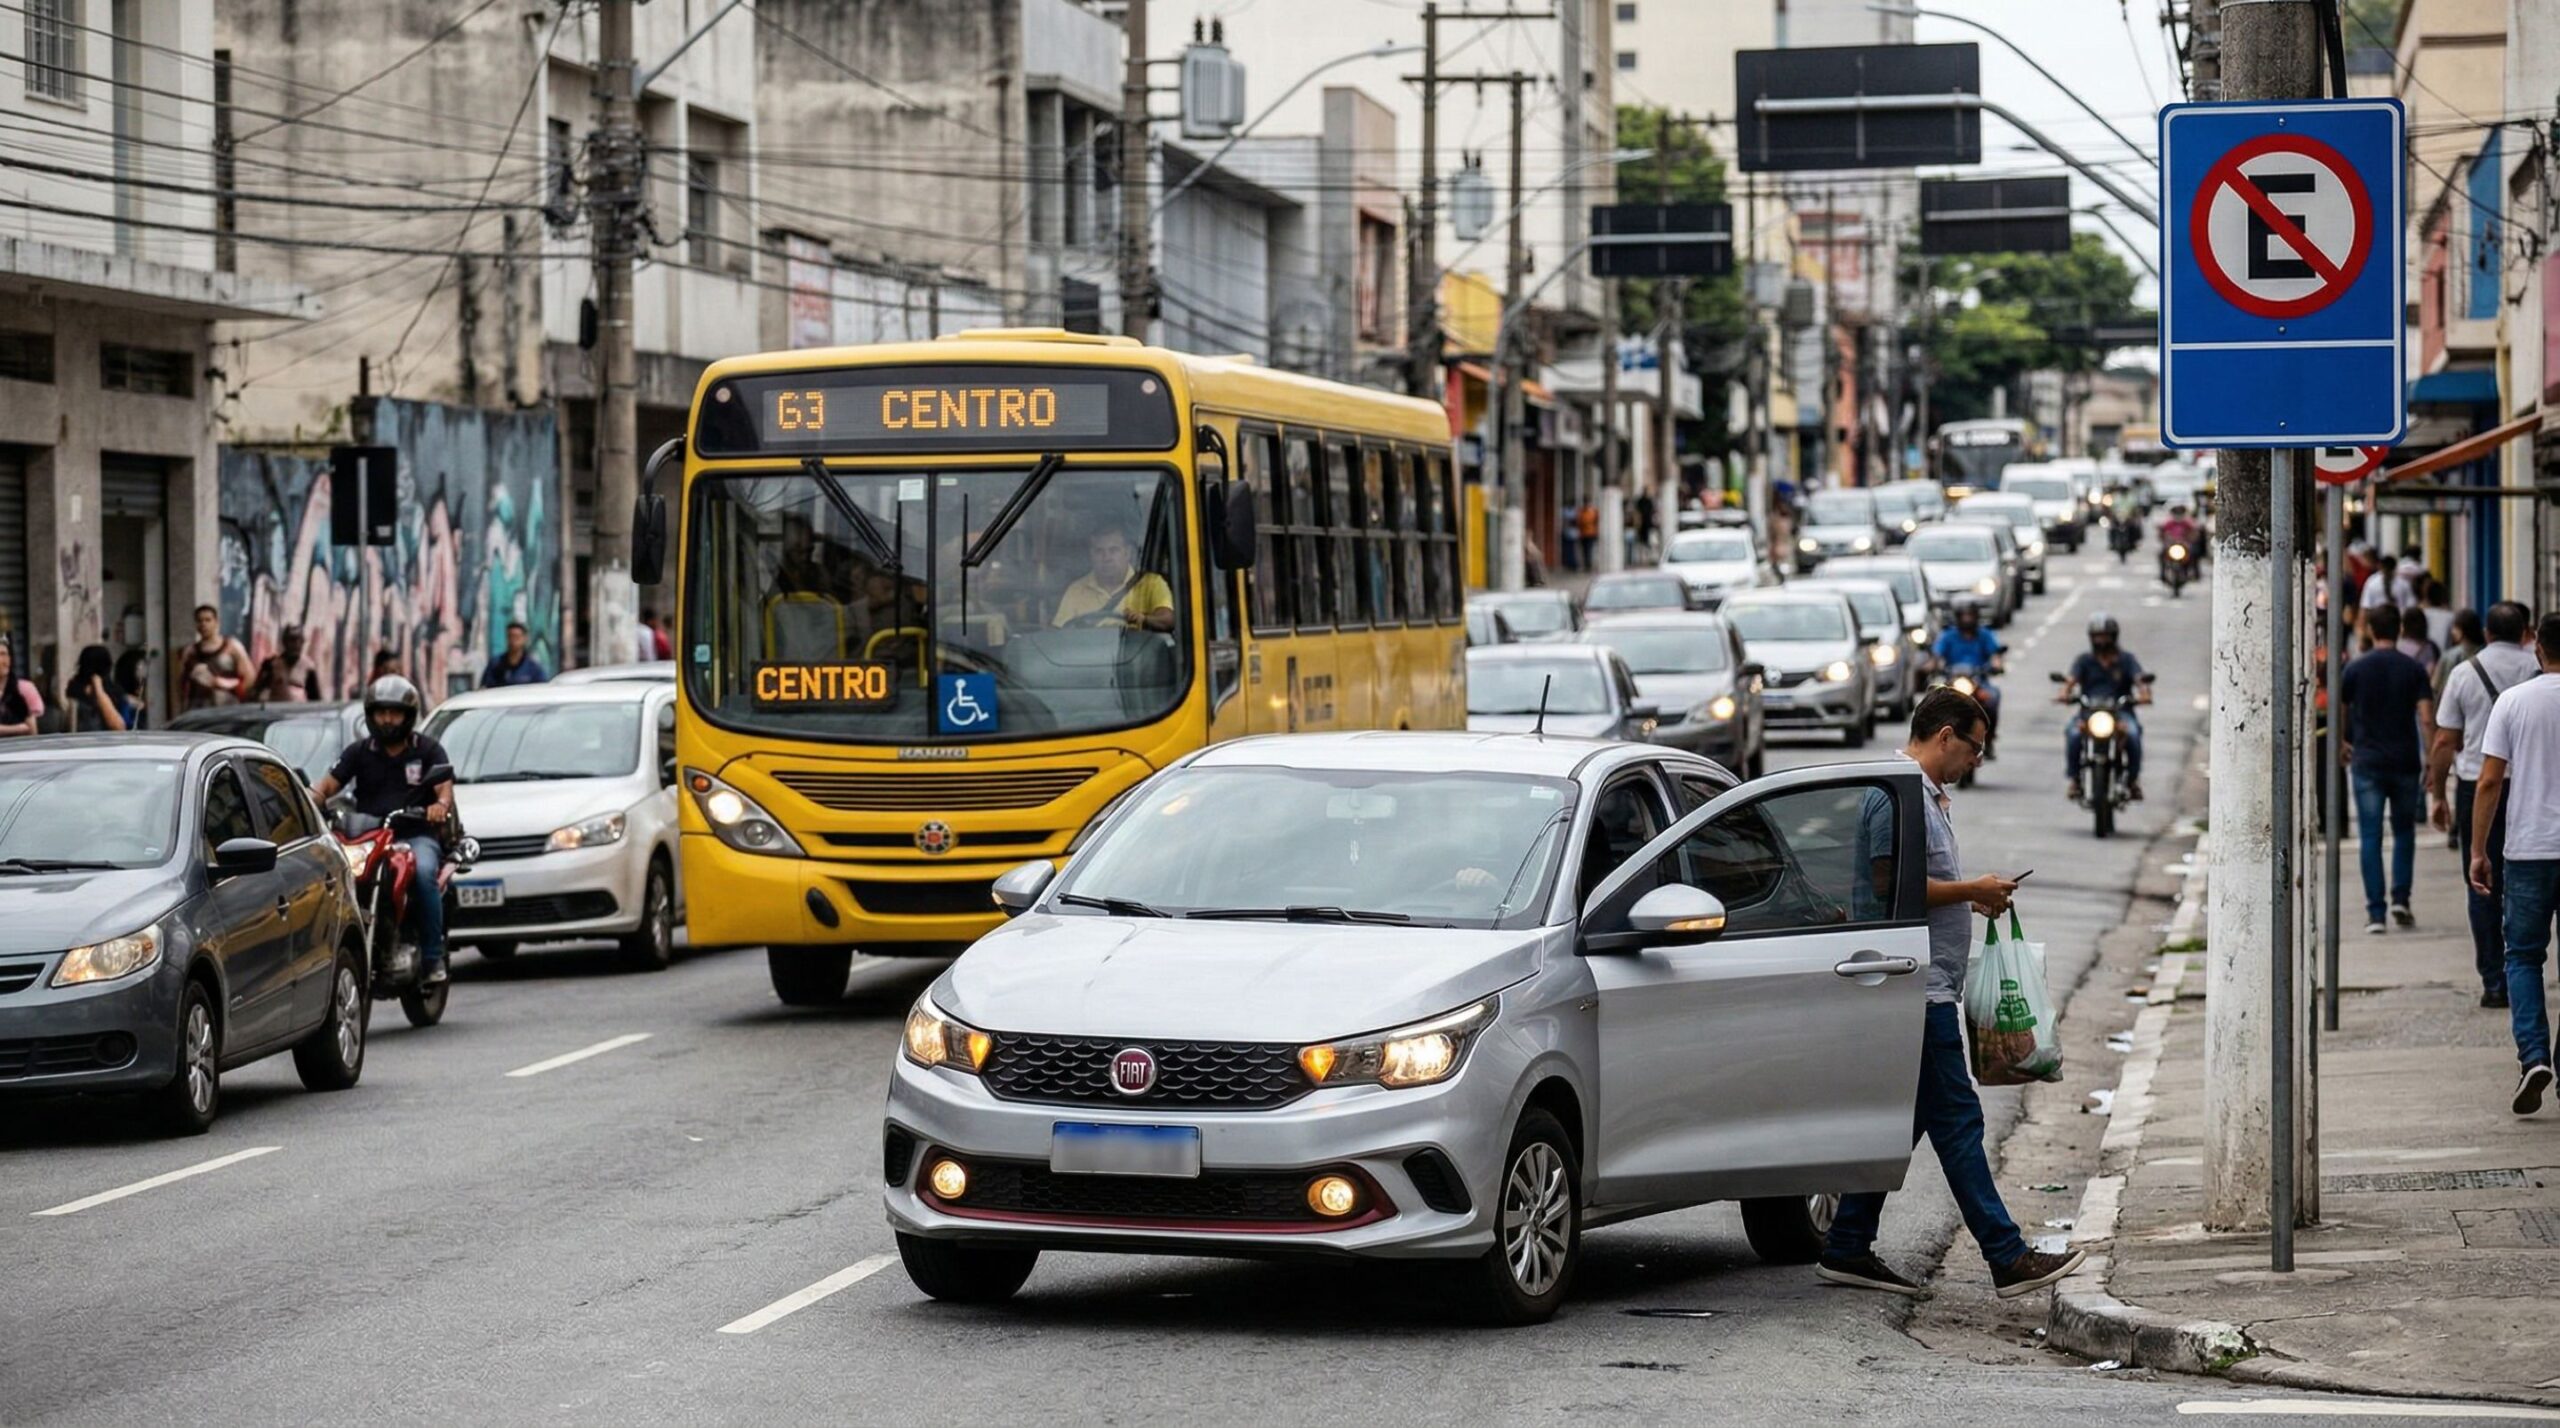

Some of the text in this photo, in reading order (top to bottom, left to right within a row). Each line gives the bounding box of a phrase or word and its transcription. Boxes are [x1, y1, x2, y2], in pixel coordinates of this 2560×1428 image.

[2248, 173, 2316, 280] E
[778, 388, 1056, 430] 63 CENTRO
[757, 666, 887, 700] CENTRO
[1120, 1062, 1146, 1083] FIAT
